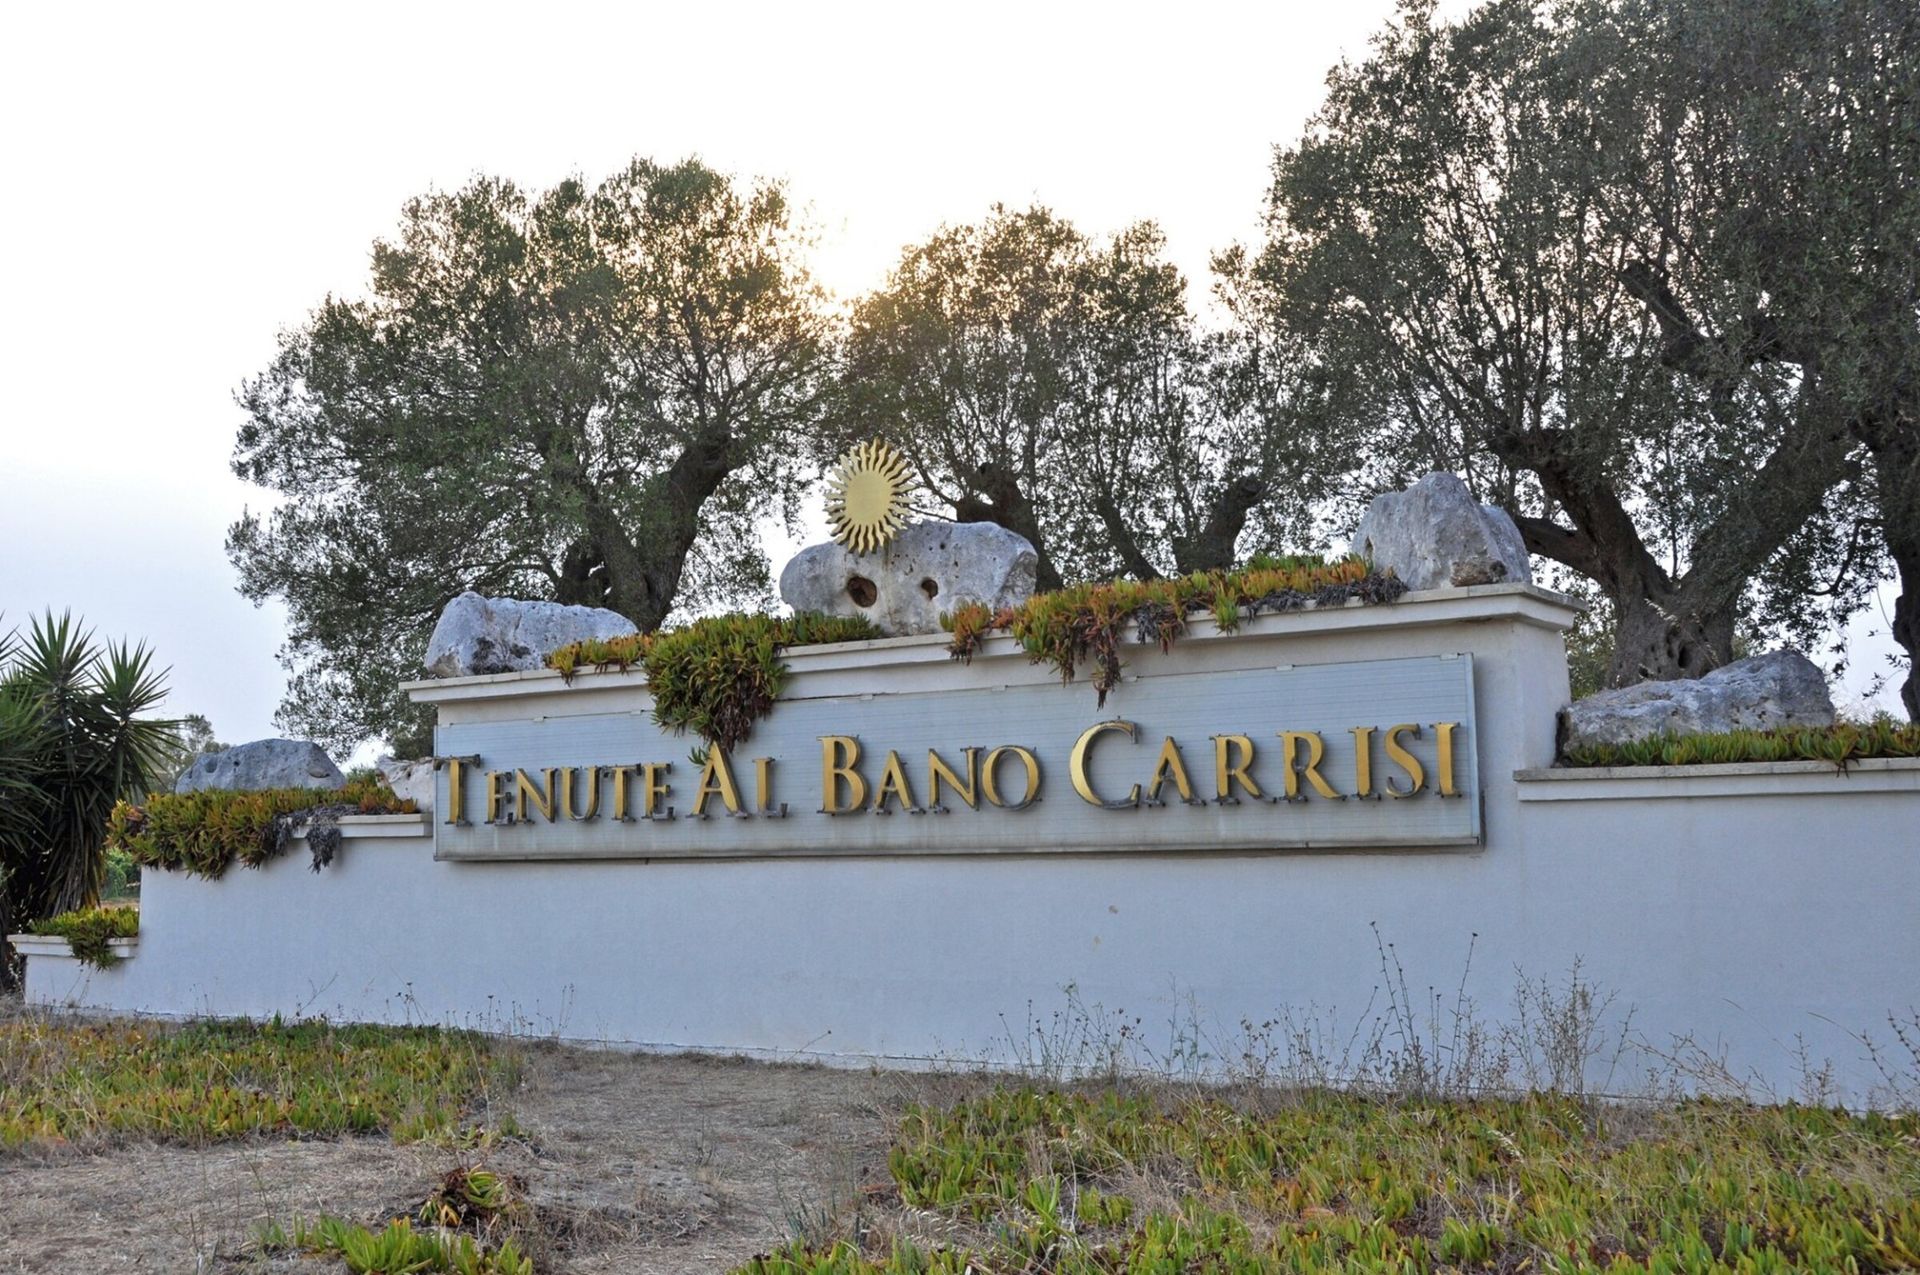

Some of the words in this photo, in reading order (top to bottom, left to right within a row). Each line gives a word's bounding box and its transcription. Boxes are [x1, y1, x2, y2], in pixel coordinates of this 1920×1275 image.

[433, 753, 676, 826] TENUTE
[691, 740, 789, 819] AL
[816, 735, 1043, 815] BANO
[1068, 716, 1462, 808] CARRISI
